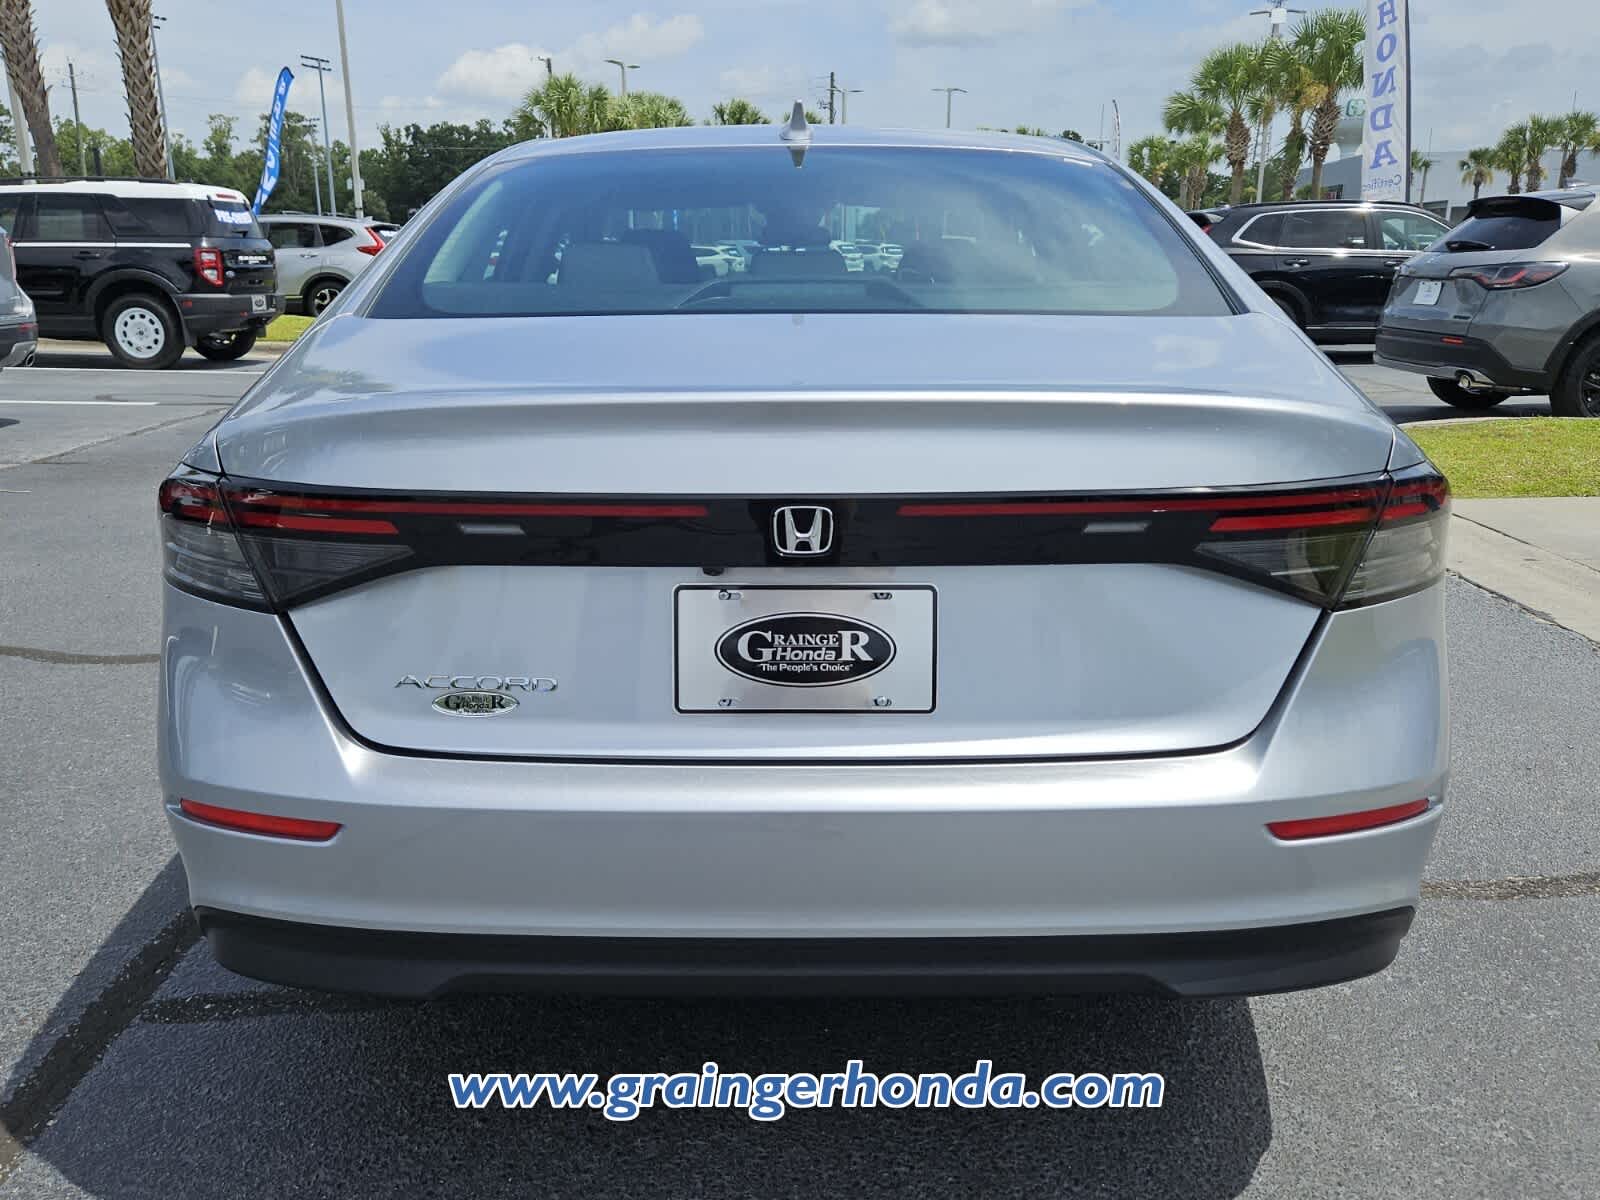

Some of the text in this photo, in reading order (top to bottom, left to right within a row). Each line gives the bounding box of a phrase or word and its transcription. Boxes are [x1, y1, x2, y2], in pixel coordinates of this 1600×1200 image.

[737, 630, 874, 663] GRAINGER
[775, 647, 837, 661] Honda
[779, 663, 818, 673] People's
[394, 674, 559, 692] ACCORD
